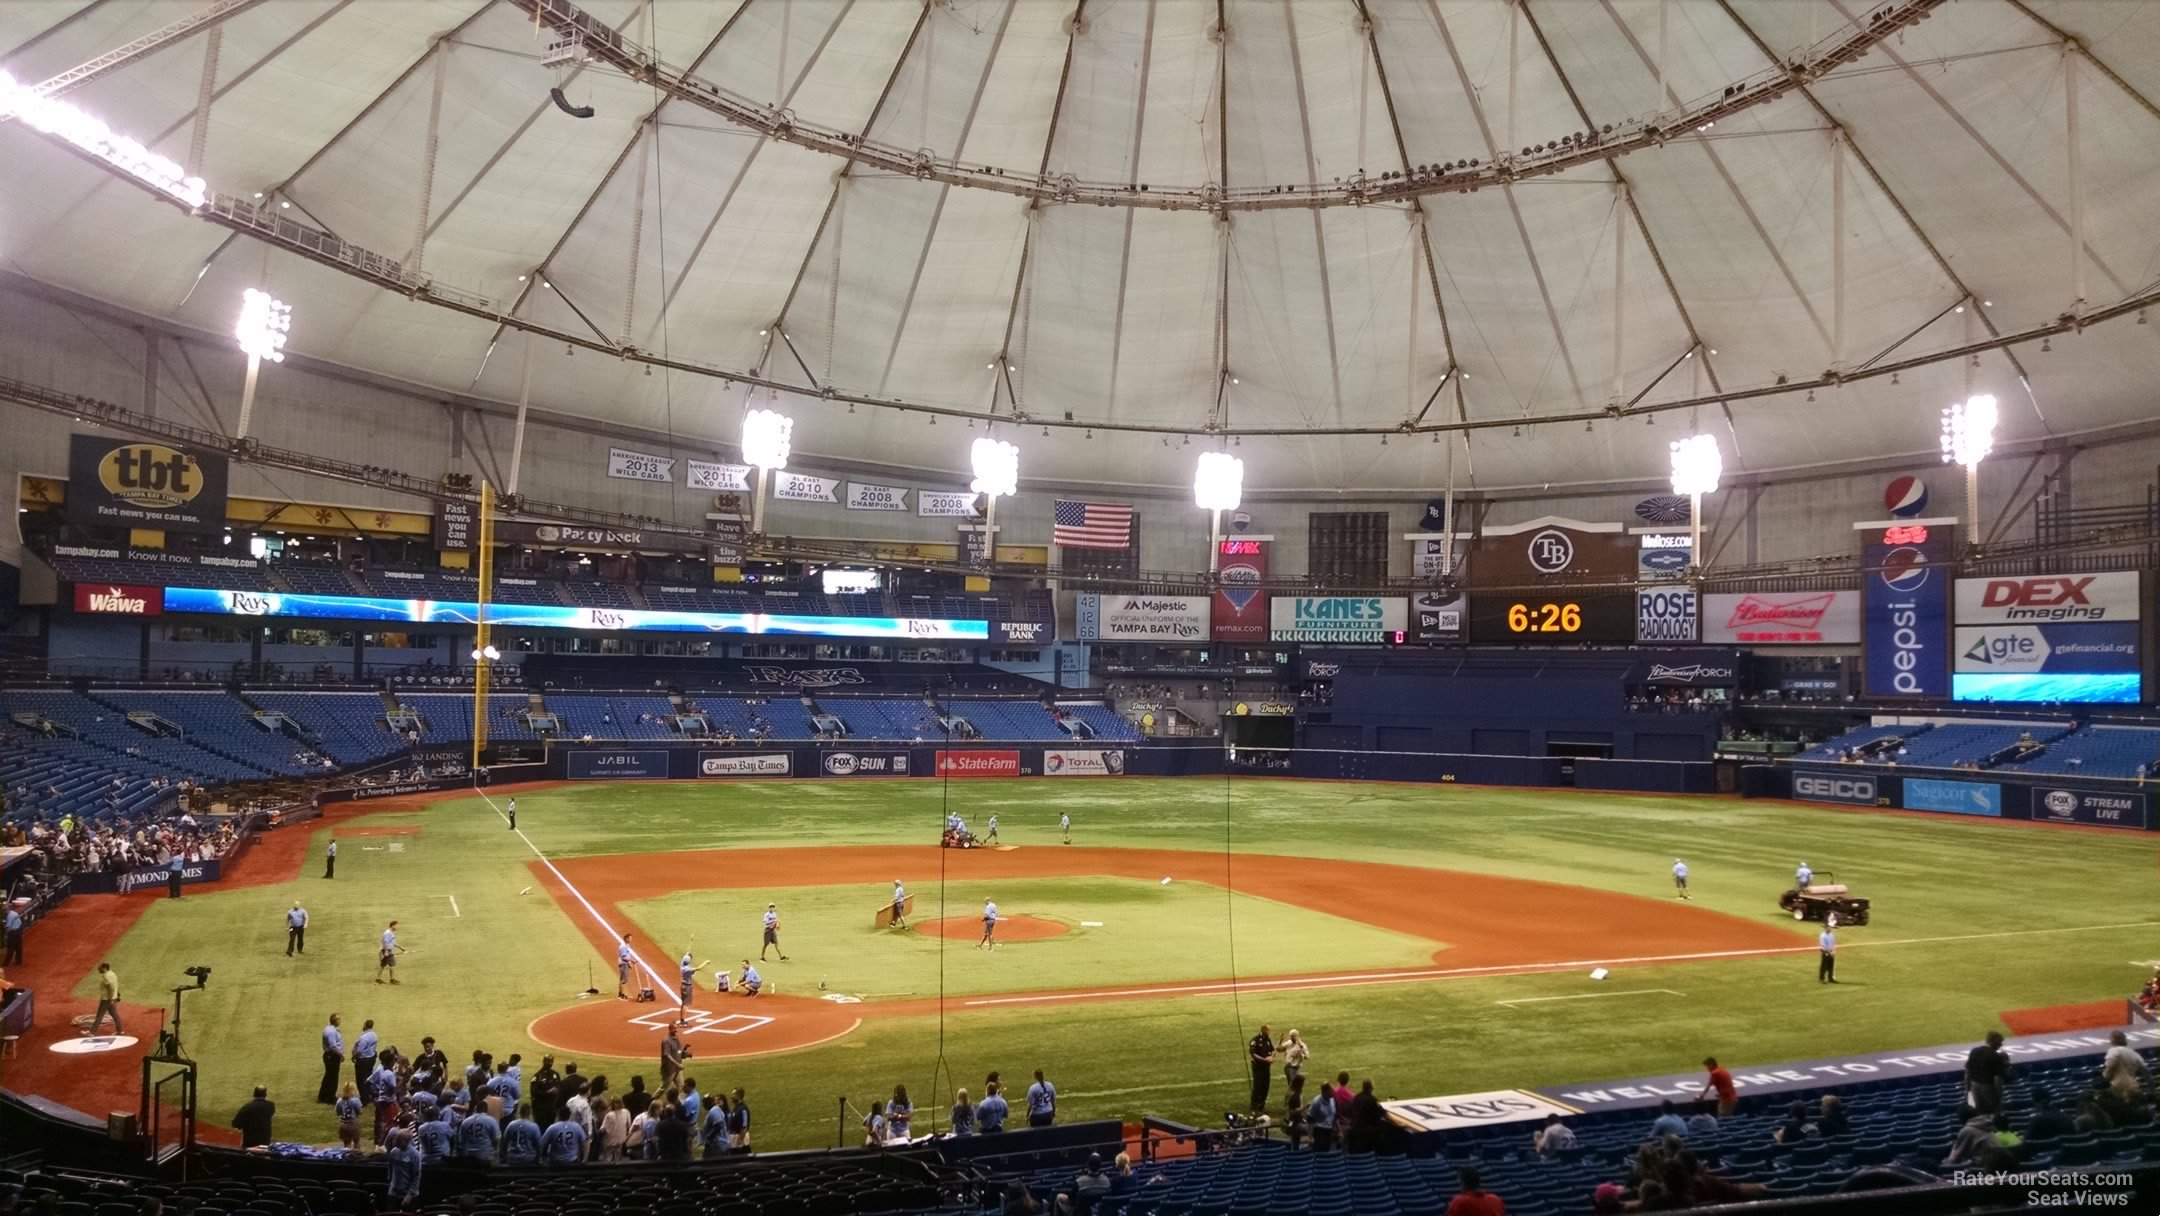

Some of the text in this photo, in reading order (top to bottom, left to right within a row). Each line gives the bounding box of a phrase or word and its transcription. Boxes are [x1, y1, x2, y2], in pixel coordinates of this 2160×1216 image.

[612, 452, 670, 466] AMERICAN LEAGUE
[114, 448, 189, 493] tbt
[626, 460, 658, 473] 2013
[689, 464, 720, 472] AMERICAN
[616, 468, 664, 480] WILD CARD
[703, 471, 733, 482] 2011
[694, 479, 740, 489] WILD CARD
[789, 481, 822, 494] 2010
[123, 491, 146, 499] TAMPA
[162, 494, 183, 504] TIMES
[778, 490, 830, 501] CHAMPIONS
[861, 491, 892, 502] 2008
[446, 503, 467, 514] Fast
[851, 500, 899, 509] CHAMPIONS
[932, 499, 963, 509] 2008
[98, 506, 200, 523] Fast news you can use.
[923, 507, 971, 515] CHAMPIONS
[444, 514, 471, 523] news
[448, 523, 467, 531] you
[716, 523, 740, 532] Have
[447, 539, 467, 548] use.
[55, 545, 119, 558] tampabay.com
[720, 547, 737, 555] the
[1537, 538, 1566, 565] TB
[128, 550, 192, 564] Know it now.
[200, 555, 258, 568] tampabay.com
[714, 554, 741, 563] buzz?
[442, 574, 460, 582] Know
[1981, 577, 2096, 607] DEX
[90, 593, 144, 613] Wawa
[1081, 597, 1095, 608] 42
[1142, 600, 1187, 613] Majestic
[1640, 593, 1695, 618] ROSE
[1296, 599, 1383, 619] KANE'S
[2007, 606, 2105, 620] imaging
[1082, 612, 1093, 623] 12
[1508, 603, 1581, 632] 6:26
[1001, 623, 1043, 631] REPUBLIC
[1080, 626, 1095, 638] 66
[1110, 624, 1148, 633] TAMPA
[1150, 624, 1171, 633] BAY
[1640, 619, 1695, 639] RADIOLOGY
[1009, 631, 1035, 639] BANK
[1888, 603, 1923, 693] pepsi
[1992, 634, 2034, 658] gte
[2055, 644, 2134, 655] gtefinancial.org
[2002, 655, 2039, 665] financial
[1653, 668, 1732, 677] Budweiser PORCH
[1260, 703, 1295, 714] Ducky's
[426, 752, 464, 761] LANDING
[598, 756, 639, 765] JABIL
[833, 758, 851, 766] FOX
[1067, 758, 1103, 766] TOTAL
[707, 759, 785, 772] Tampa Bay Times
[860, 758, 886, 770] SUN
[958, 757, 1016, 770] StateFarm
[367, 786, 395, 797] Petersburg
[1796, 777, 1873, 798] GEICO
[1912, 781, 1966, 801] Sagicor
[2052, 795, 2069, 804] FOX
[2084, 797, 2132, 809] STREAM
[2096, 809, 2120, 819] LIVE
[131, 867, 202, 884] YMOND MES
[1811, 1062, 1880, 1076] TO
[468, 1123, 483, 1137] 42
[557, 1131, 574, 1145] 42
